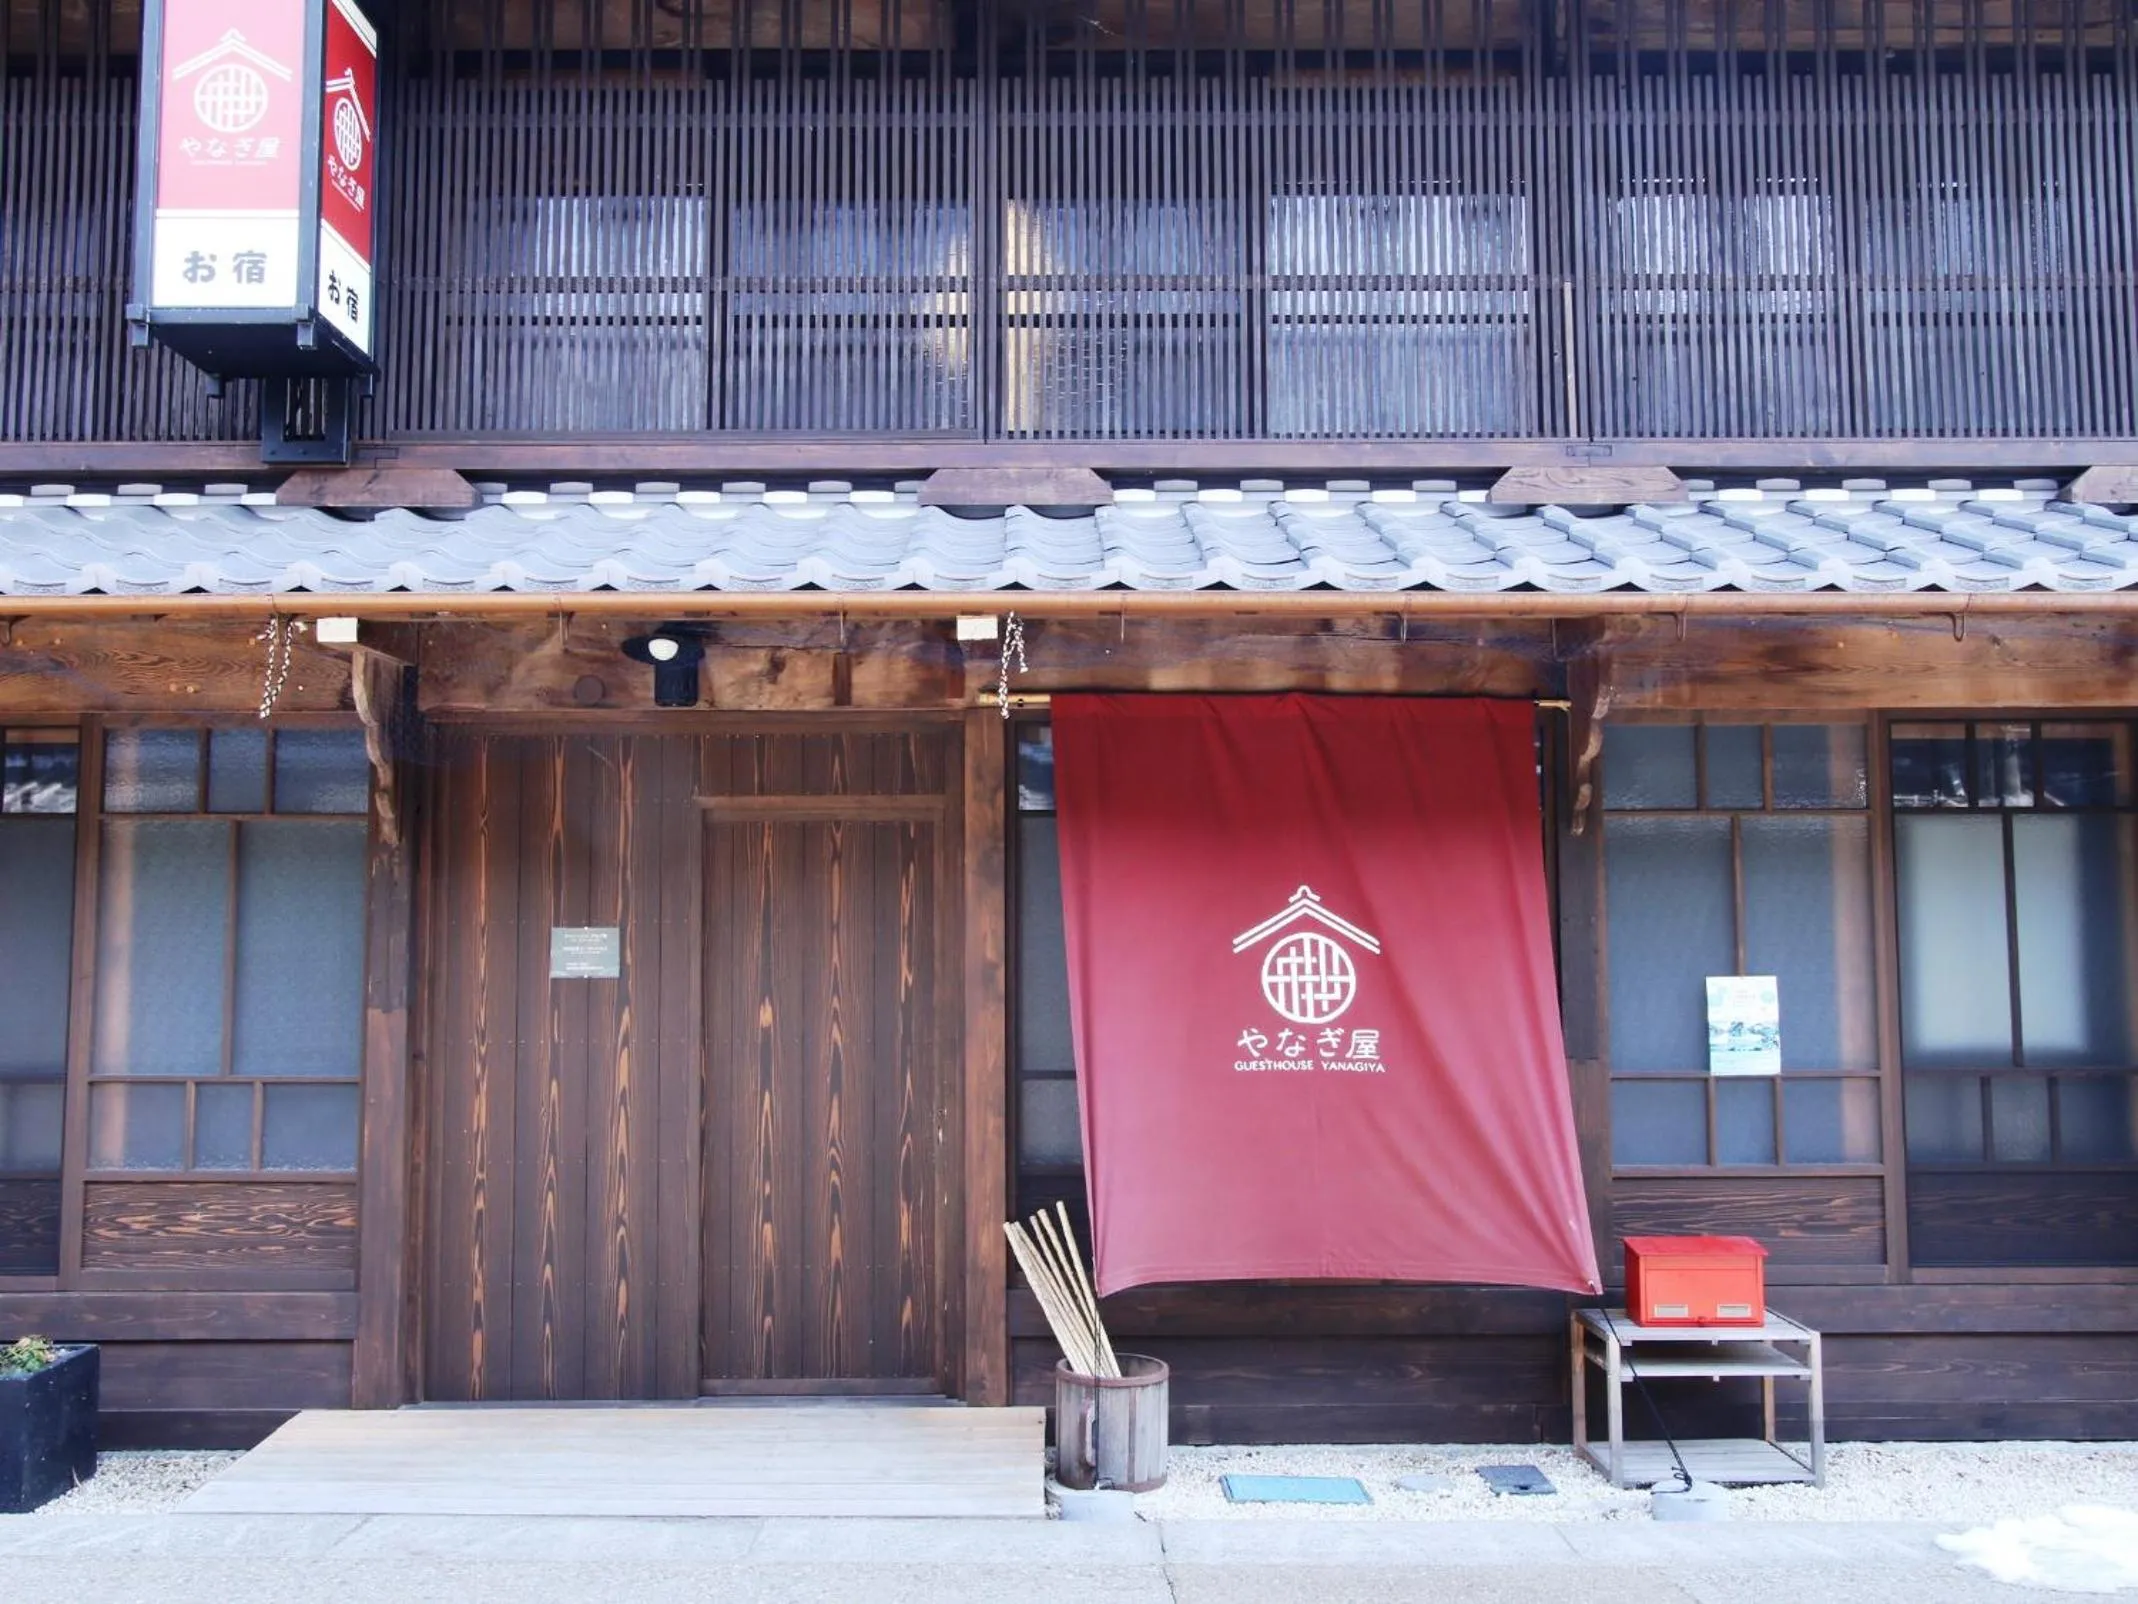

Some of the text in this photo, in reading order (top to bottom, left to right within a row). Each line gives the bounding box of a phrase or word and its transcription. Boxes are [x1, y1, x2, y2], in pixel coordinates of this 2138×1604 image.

[179, 136, 281, 159] やなぎ屋
[182, 249, 268, 284] お宿
[327, 269, 359, 322] お宿
[1236, 1027, 1381, 1060] やなぎ屋
[1233, 1059, 1386, 1073] GUESTHOUSE YANAGIYA
